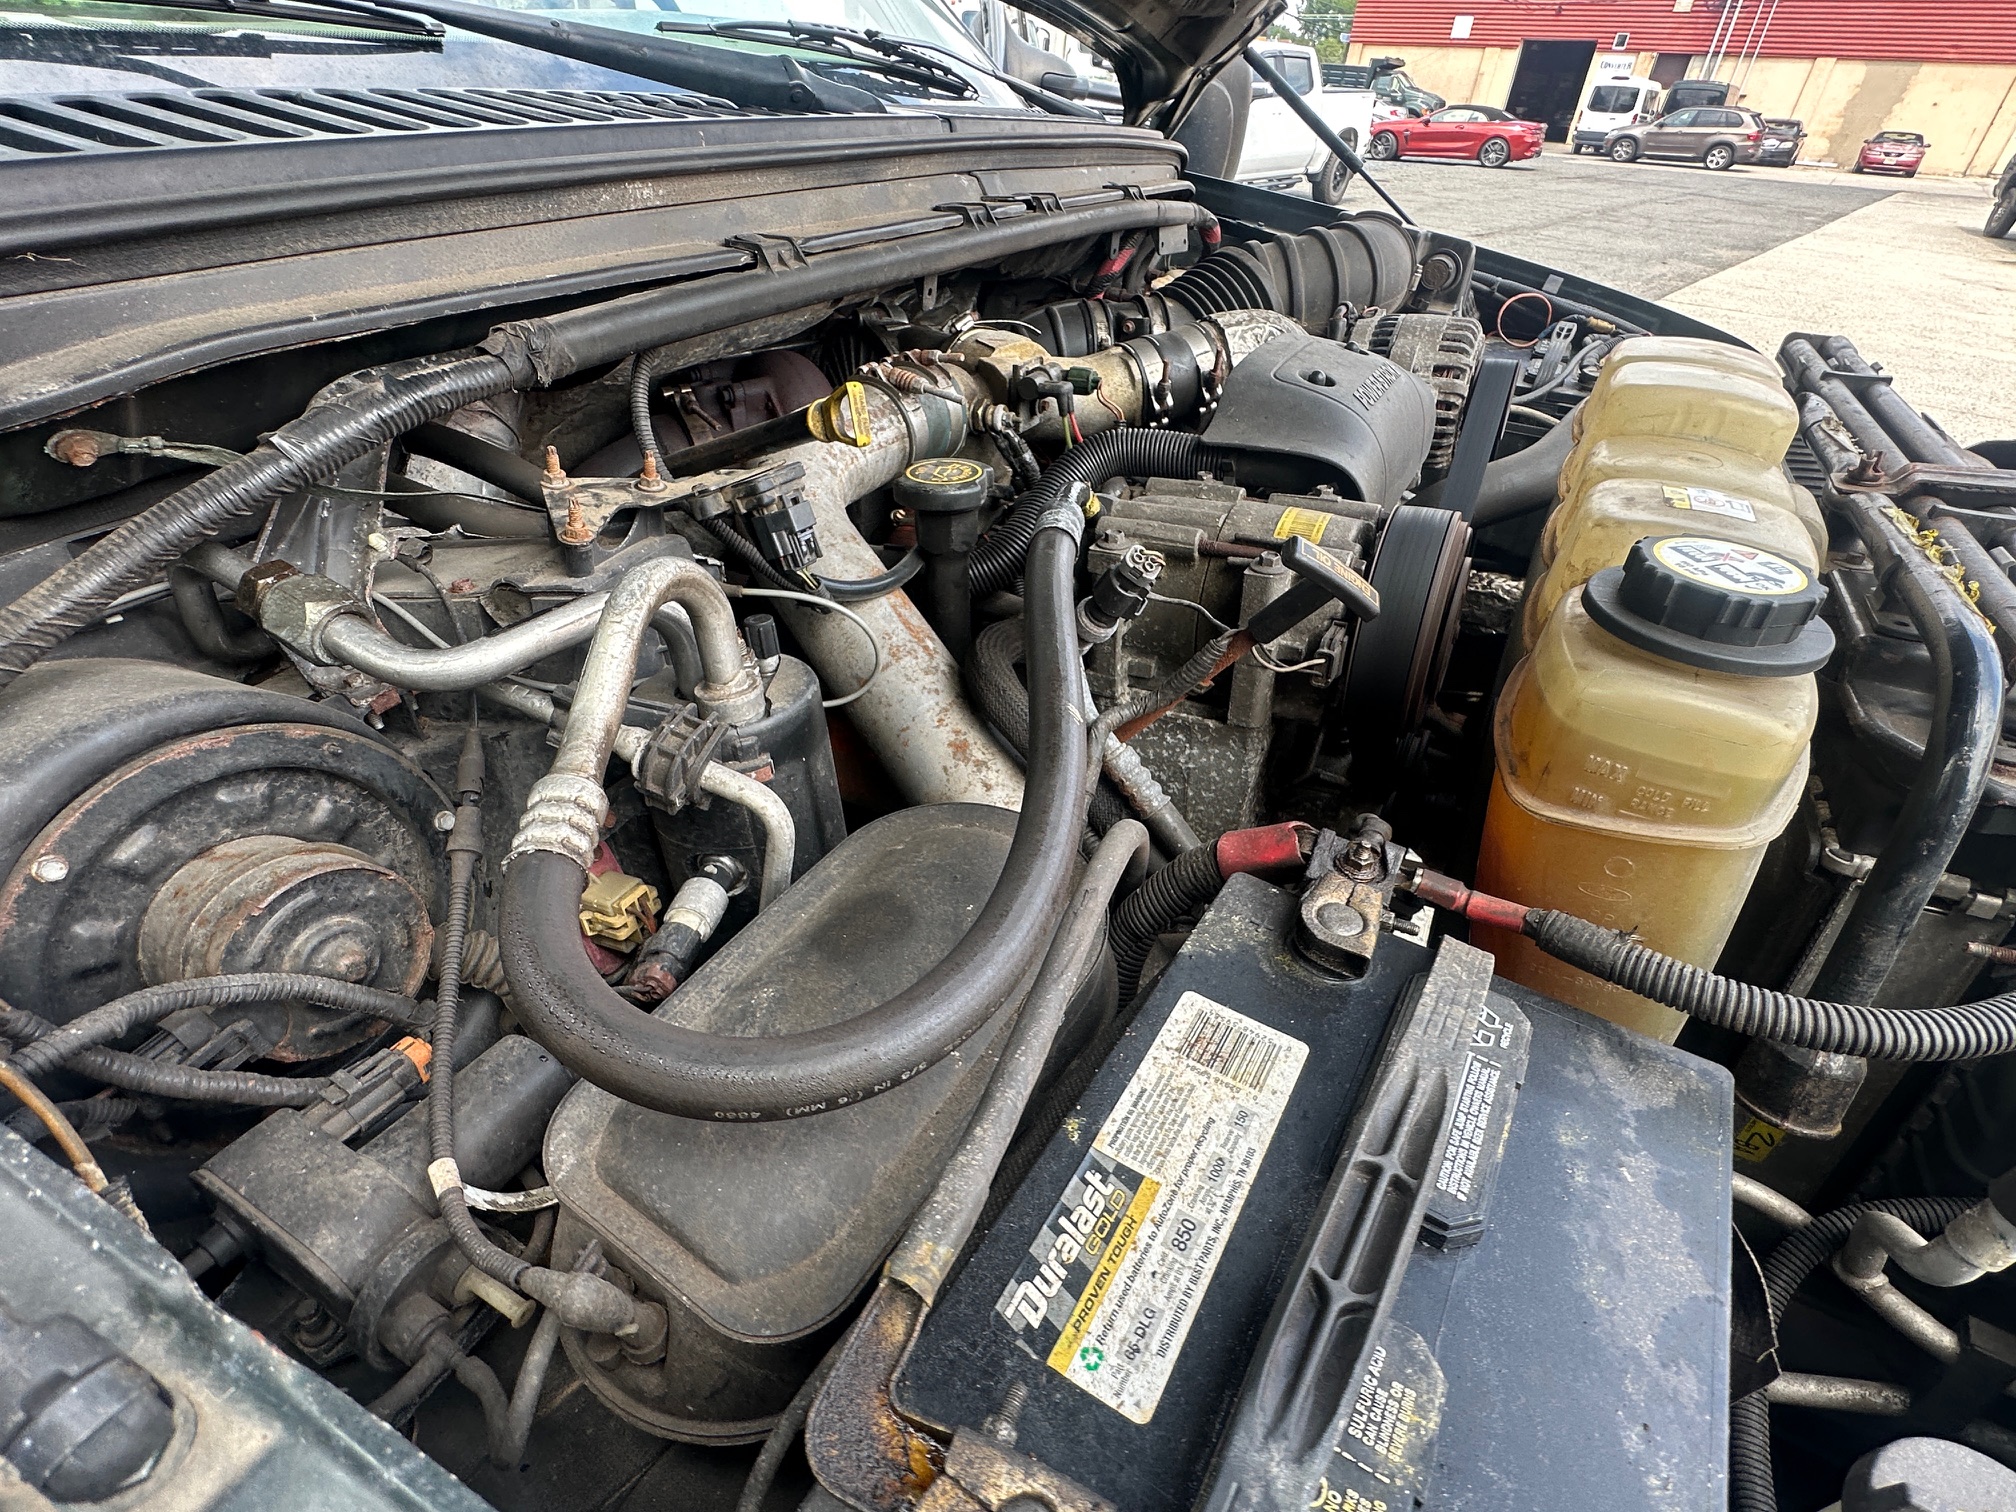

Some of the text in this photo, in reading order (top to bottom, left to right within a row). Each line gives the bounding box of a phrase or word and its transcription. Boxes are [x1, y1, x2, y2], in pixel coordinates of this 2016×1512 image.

[1312, 548, 1371, 596] ENGINE OIL
[1500, 1022, 1514, 1050] RECYCLE
[874, 1080, 891, 1092] IN
[786, 1101, 826, 1116] MM)
[1233, 1109, 1248, 1127] 150
[1448, 1127, 1462, 1146] SAFE
[1241, 1147, 1256, 1168] 38103
[1444, 1144, 1457, 1160] FOR
[1207, 1157, 1225, 1183] 1000
[1236, 1167, 1247, 1178] TN
[1458, 1176, 1470, 1193] NOT
[1220, 1178, 1243, 1215] MEMPHIS,
[1084, 1189, 1127, 1255] GOLD
[1095, 1307, 1118, 1344] Return
[1113, 1282, 1131, 1308] used
[1126, 1240, 1152, 1283] batteries
[1152, 1189, 1178, 1230] AutoZone
[1173, 1175, 1185, 1189] for
[1181, 1150, 1199, 1176] proper
[1193, 1116, 1216, 1151] recycling
[1171, 1217, 1196, 1251] 850
[1004, 1169, 1114, 1329] Duralast
[1198, 1234, 1218, 1264] PARTS,
[1073, 1217, 1138, 1332] PROVEN TOUGH
[1189, 1263, 1204, 1285] BEST
[1183, 1284, 1194, 1298] BY
[1156, 1297, 1189, 1357] DISTRIBUTED
[1113, 1367, 1132, 1399] Number
[1348, 1346, 1387, 1439] SULFURIC ACID
[1362, 1388, 1389, 1446] CAN CAUSE
[1375, 1381, 1404, 1455] BLINDNESS OR
[1388, 1387, 1417, 1462] SEVERE BURNS
[1323, 1490, 1342, 1512] NO
